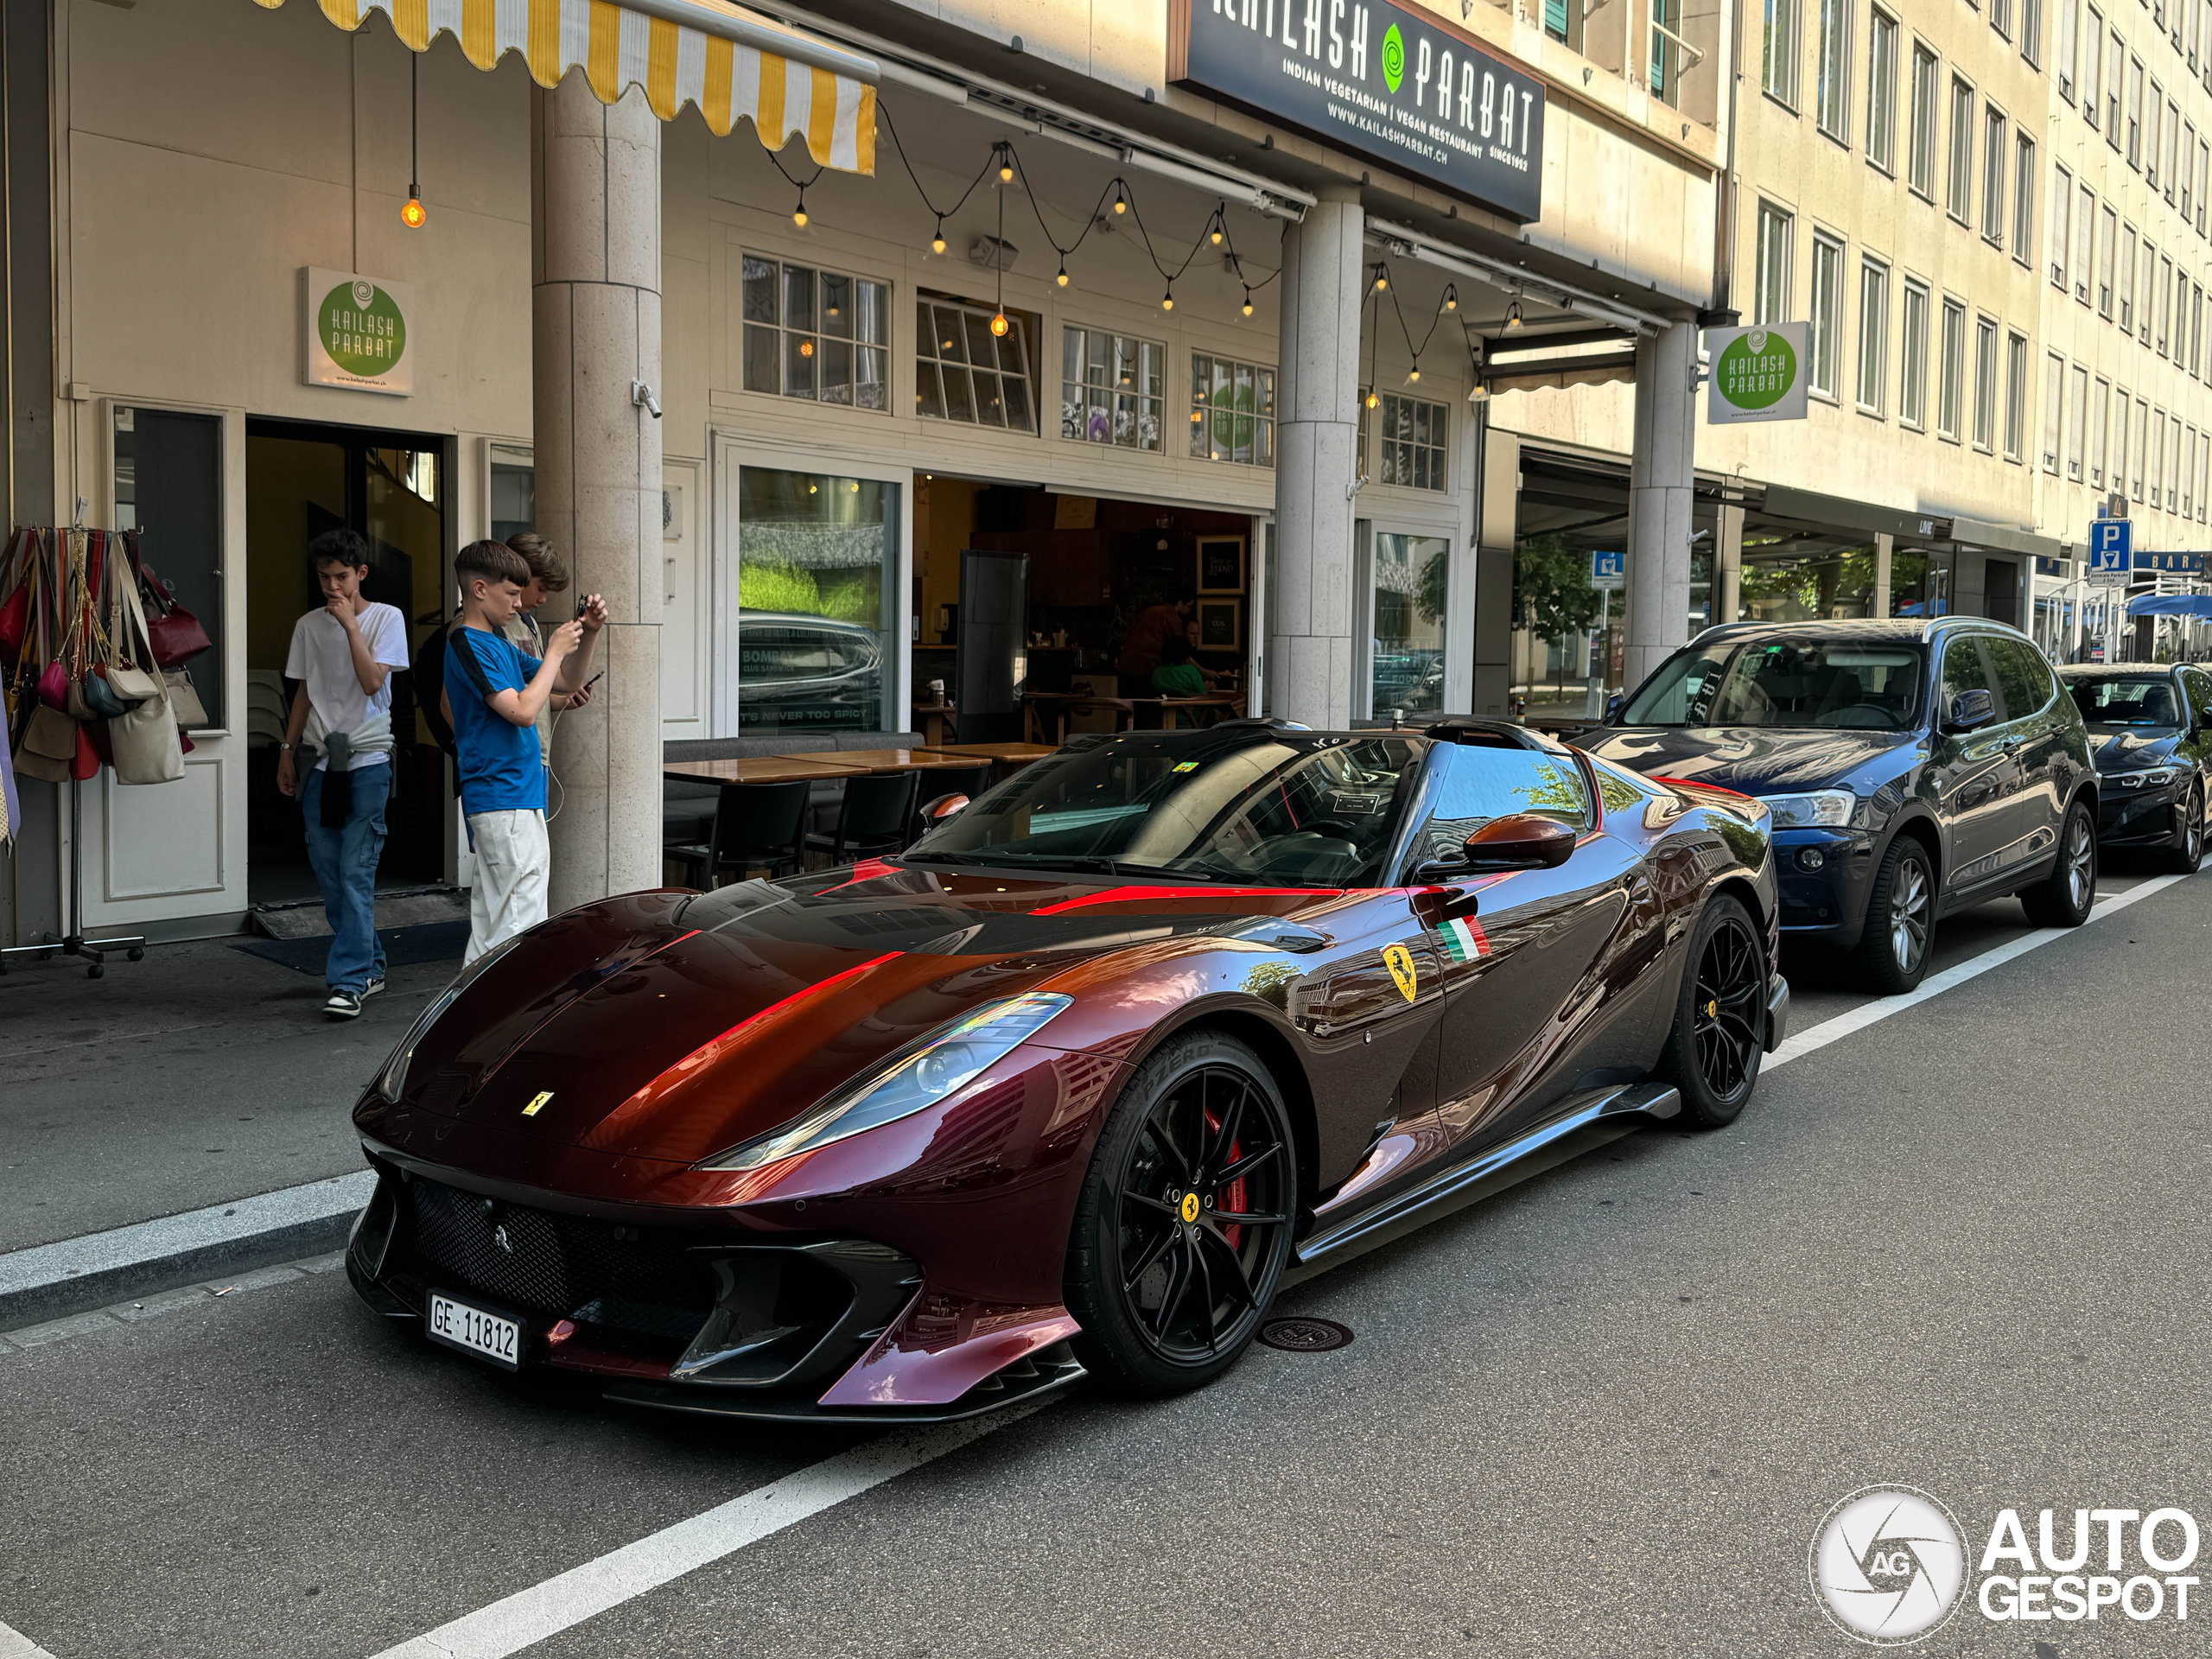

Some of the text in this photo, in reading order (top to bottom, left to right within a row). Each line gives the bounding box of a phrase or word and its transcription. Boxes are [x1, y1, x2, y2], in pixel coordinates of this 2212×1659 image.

[1282, 57, 1321, 88] INDIAN
[1324, 75, 1388, 117] VEGETARIAN
[1396, 107, 1427, 135] VEGAN
[1428, 124, 1484, 160] RESTAURANT
[1415, 37, 1534, 156] PARBAT
[1327, 101, 1449, 166] WWW.KAILASHPARBAT.CH
[332, 308, 394, 338] KAILASH
[332, 331, 394, 359] PARBAT
[1729, 354, 1786, 376] KAILASH
[1728, 373, 1784, 394] PARBAT
[2102, 525, 2120, 550] P
[742, 650, 794, 664] BOMBAY
[762, 711, 804, 721] NEVER
[807, 710, 831, 720] TOO
[834, 709, 868, 719] SPICY
[435, 1300, 514, 1358] GE 11812
